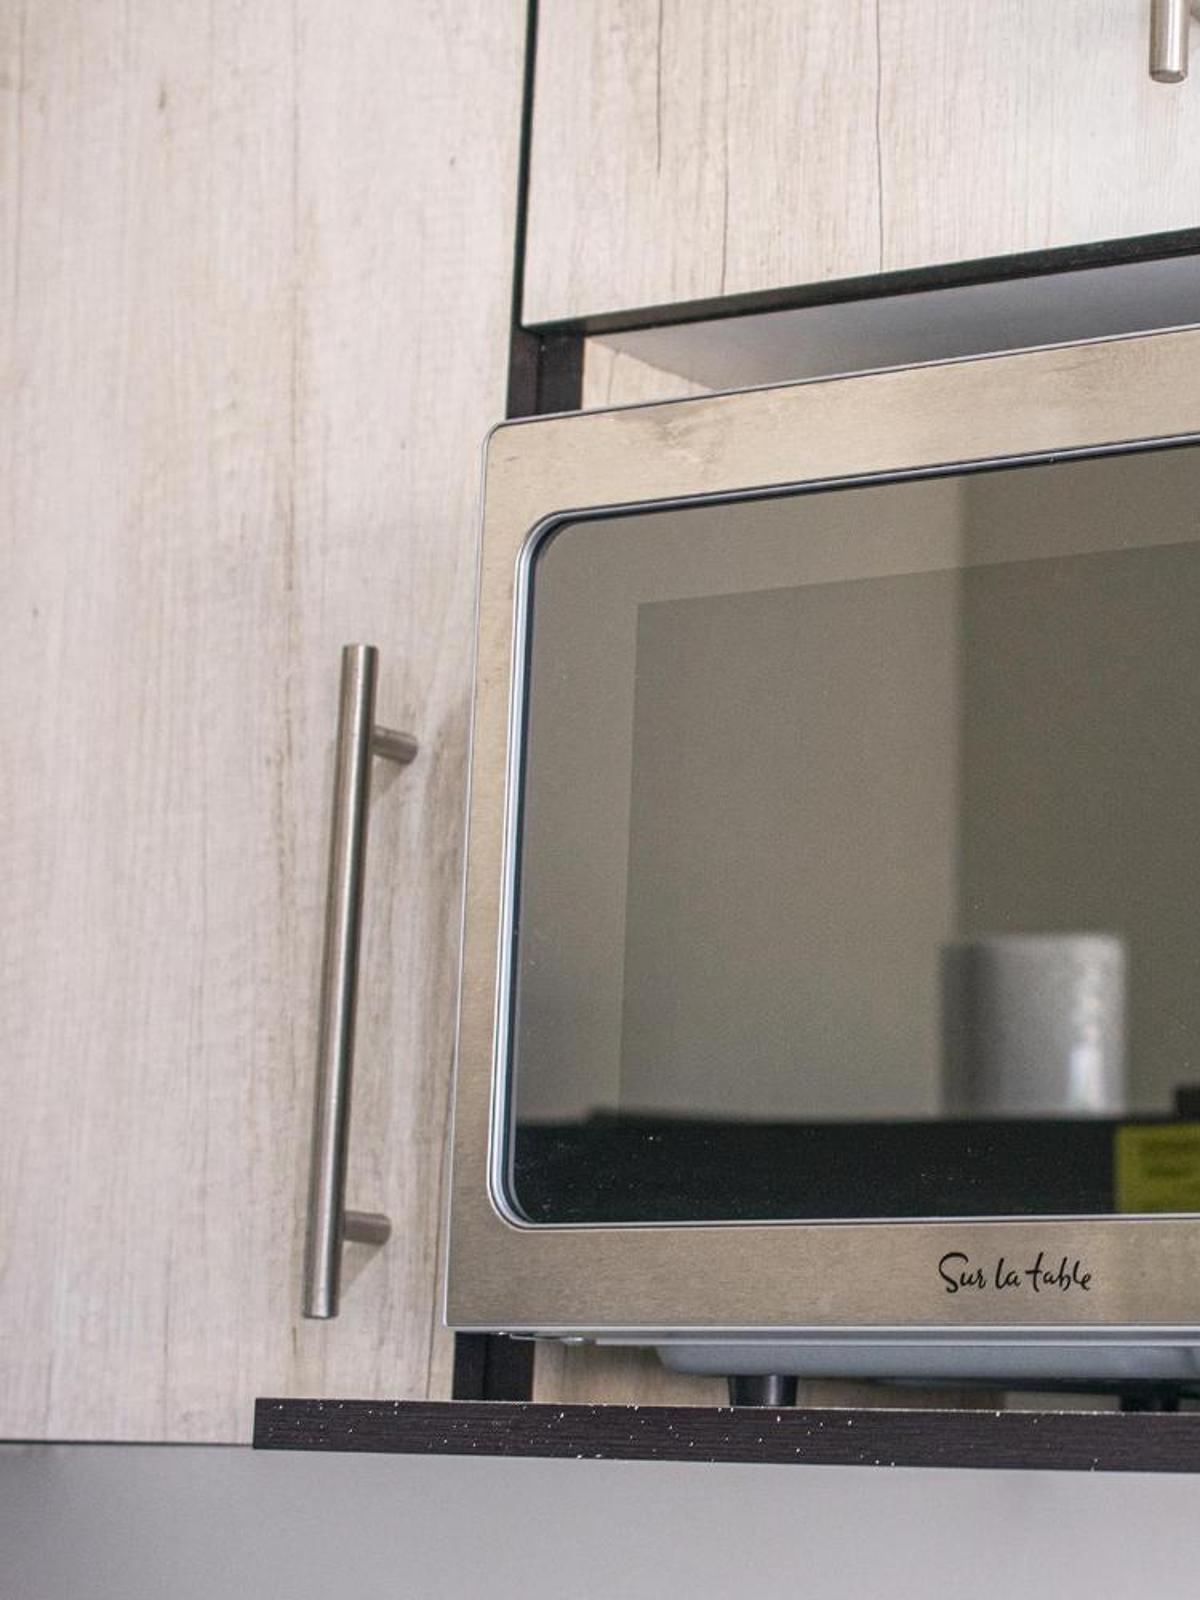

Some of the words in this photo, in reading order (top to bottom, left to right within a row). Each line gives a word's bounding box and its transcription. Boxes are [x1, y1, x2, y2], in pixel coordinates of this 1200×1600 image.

[938, 1251, 988, 1293] Sur
[994, 1257, 1021, 1290] la
[1024, 1251, 1093, 1293] table
